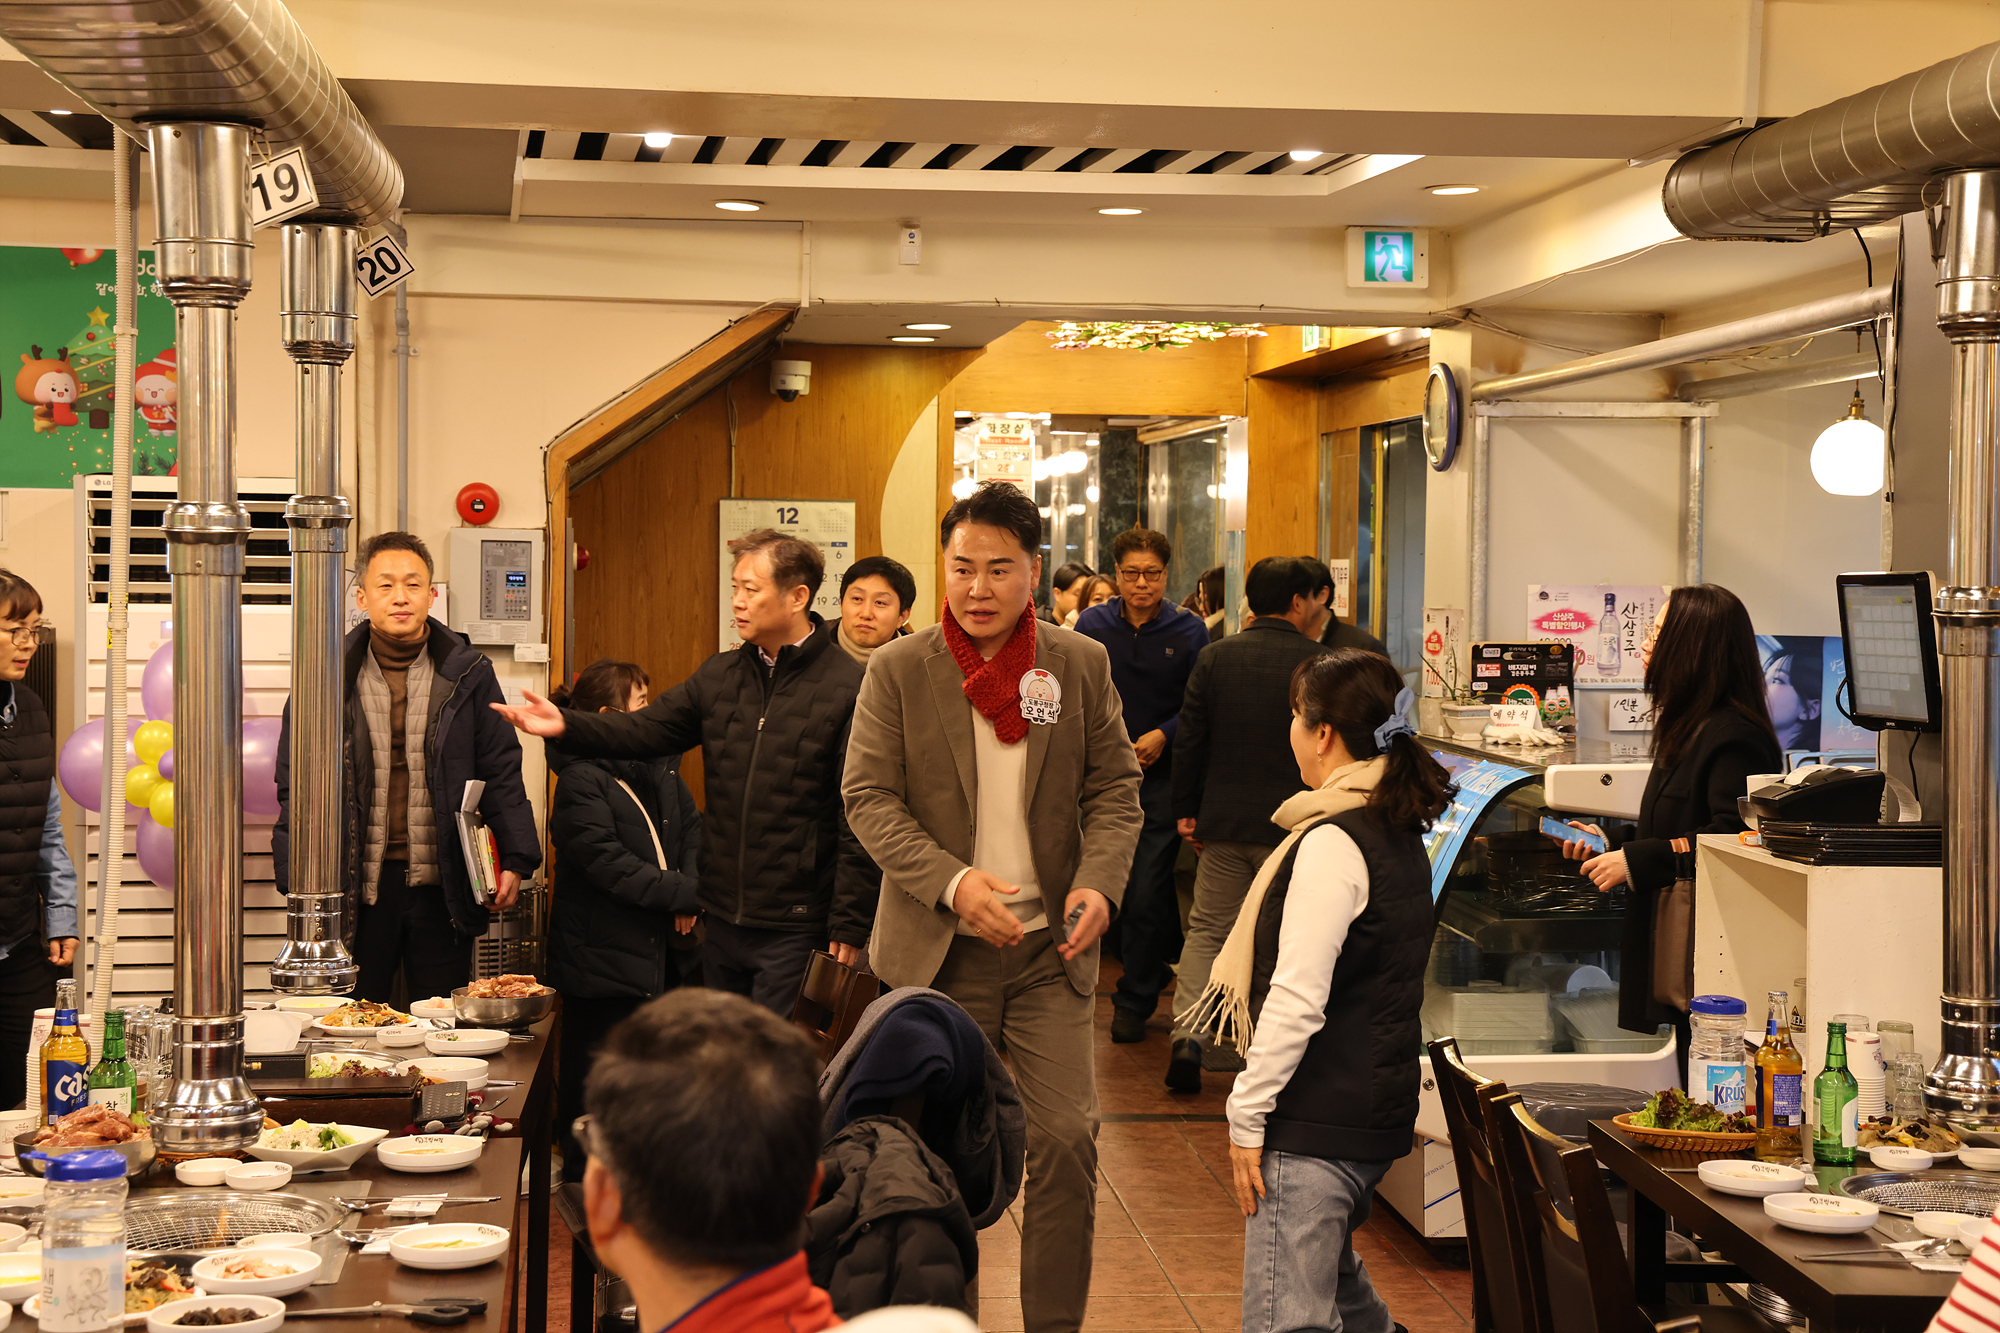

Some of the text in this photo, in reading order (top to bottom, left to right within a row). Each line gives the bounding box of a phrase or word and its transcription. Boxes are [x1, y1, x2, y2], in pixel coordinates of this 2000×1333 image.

[252, 163, 300, 212] 19
[357, 246, 401, 287] 20
[777, 508, 799, 524] 12
[836, 551, 842, 559] 6
[817, 597, 828, 606] 19
[1552, 612, 1575, 621] 산삼주
[1541, 621, 1586, 630] 특별할인행사
[1620, 601, 1639, 657] 산삼주
[1025, 705, 1056, 721] 오언석
[1493, 709, 1529, 721] 예약석
[43, 1267, 55, 1305] 새로
